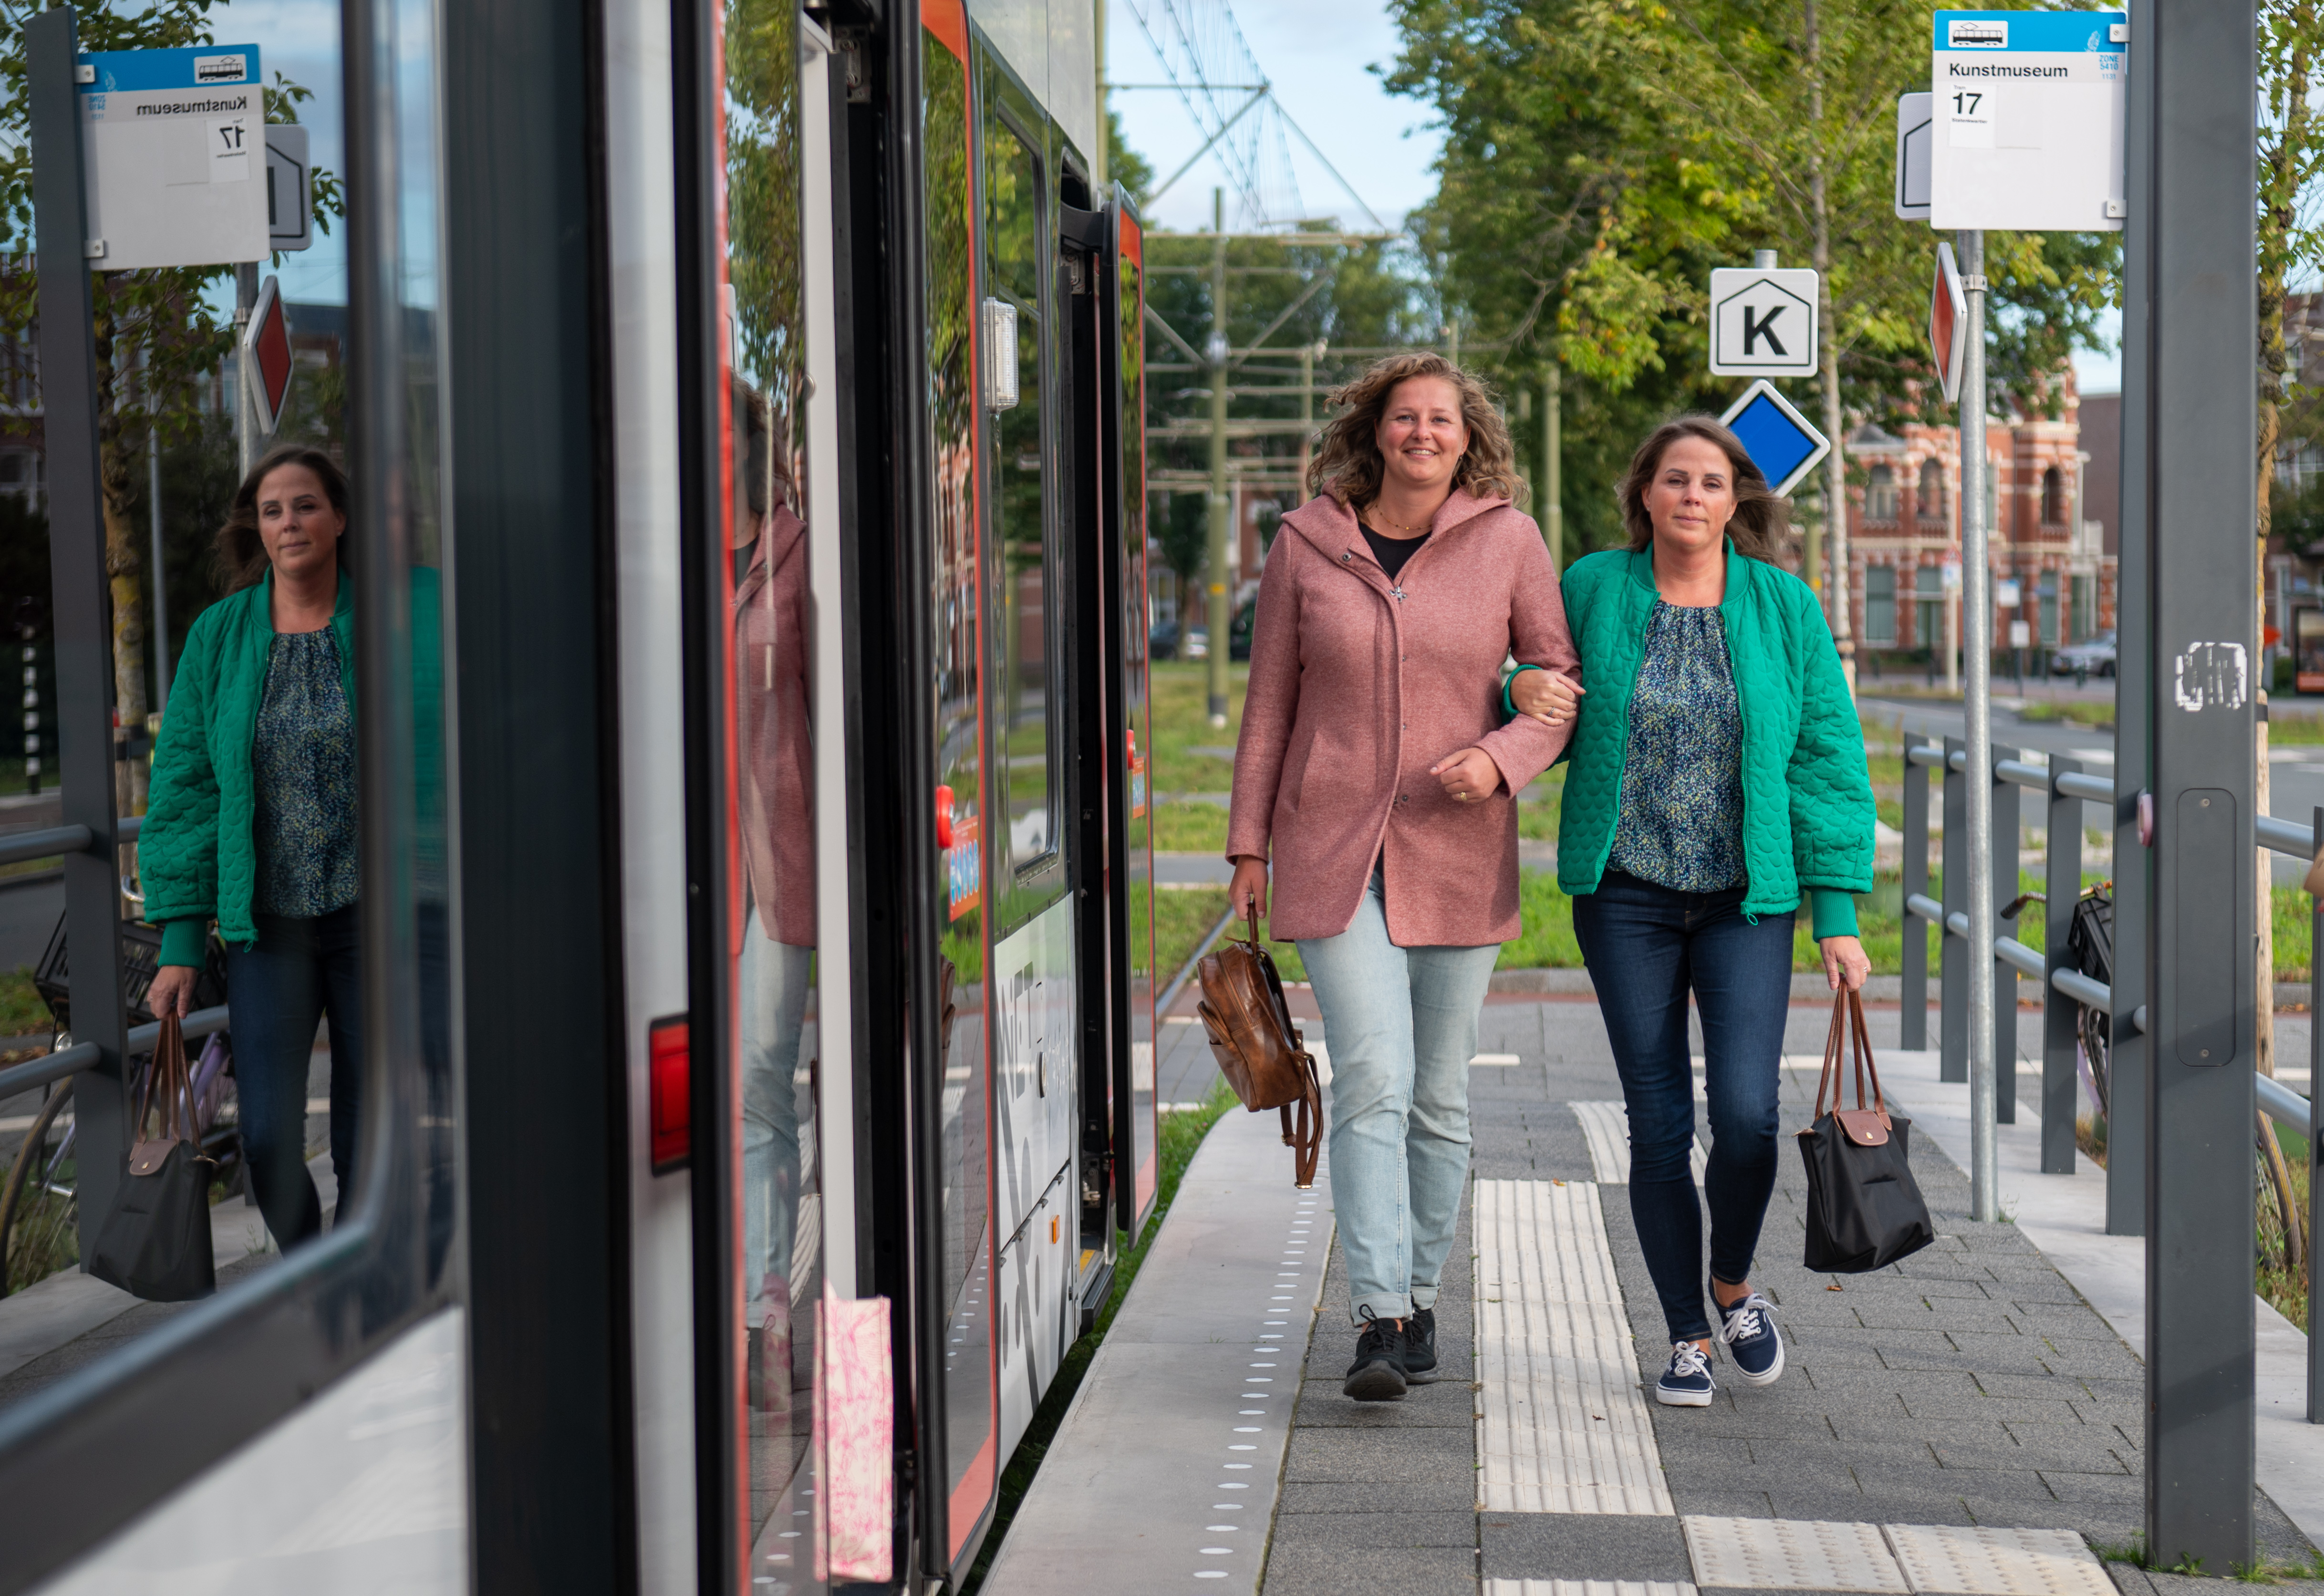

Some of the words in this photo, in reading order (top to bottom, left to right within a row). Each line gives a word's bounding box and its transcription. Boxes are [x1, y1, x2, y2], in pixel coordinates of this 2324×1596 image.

[2099, 54, 2119, 62] ZONE
[1950, 63, 2068, 78] Kunstmuseum
[2099, 62, 2119, 71] 5410
[1952, 92, 1983, 115] 17
[1744, 306, 1789, 356] K
